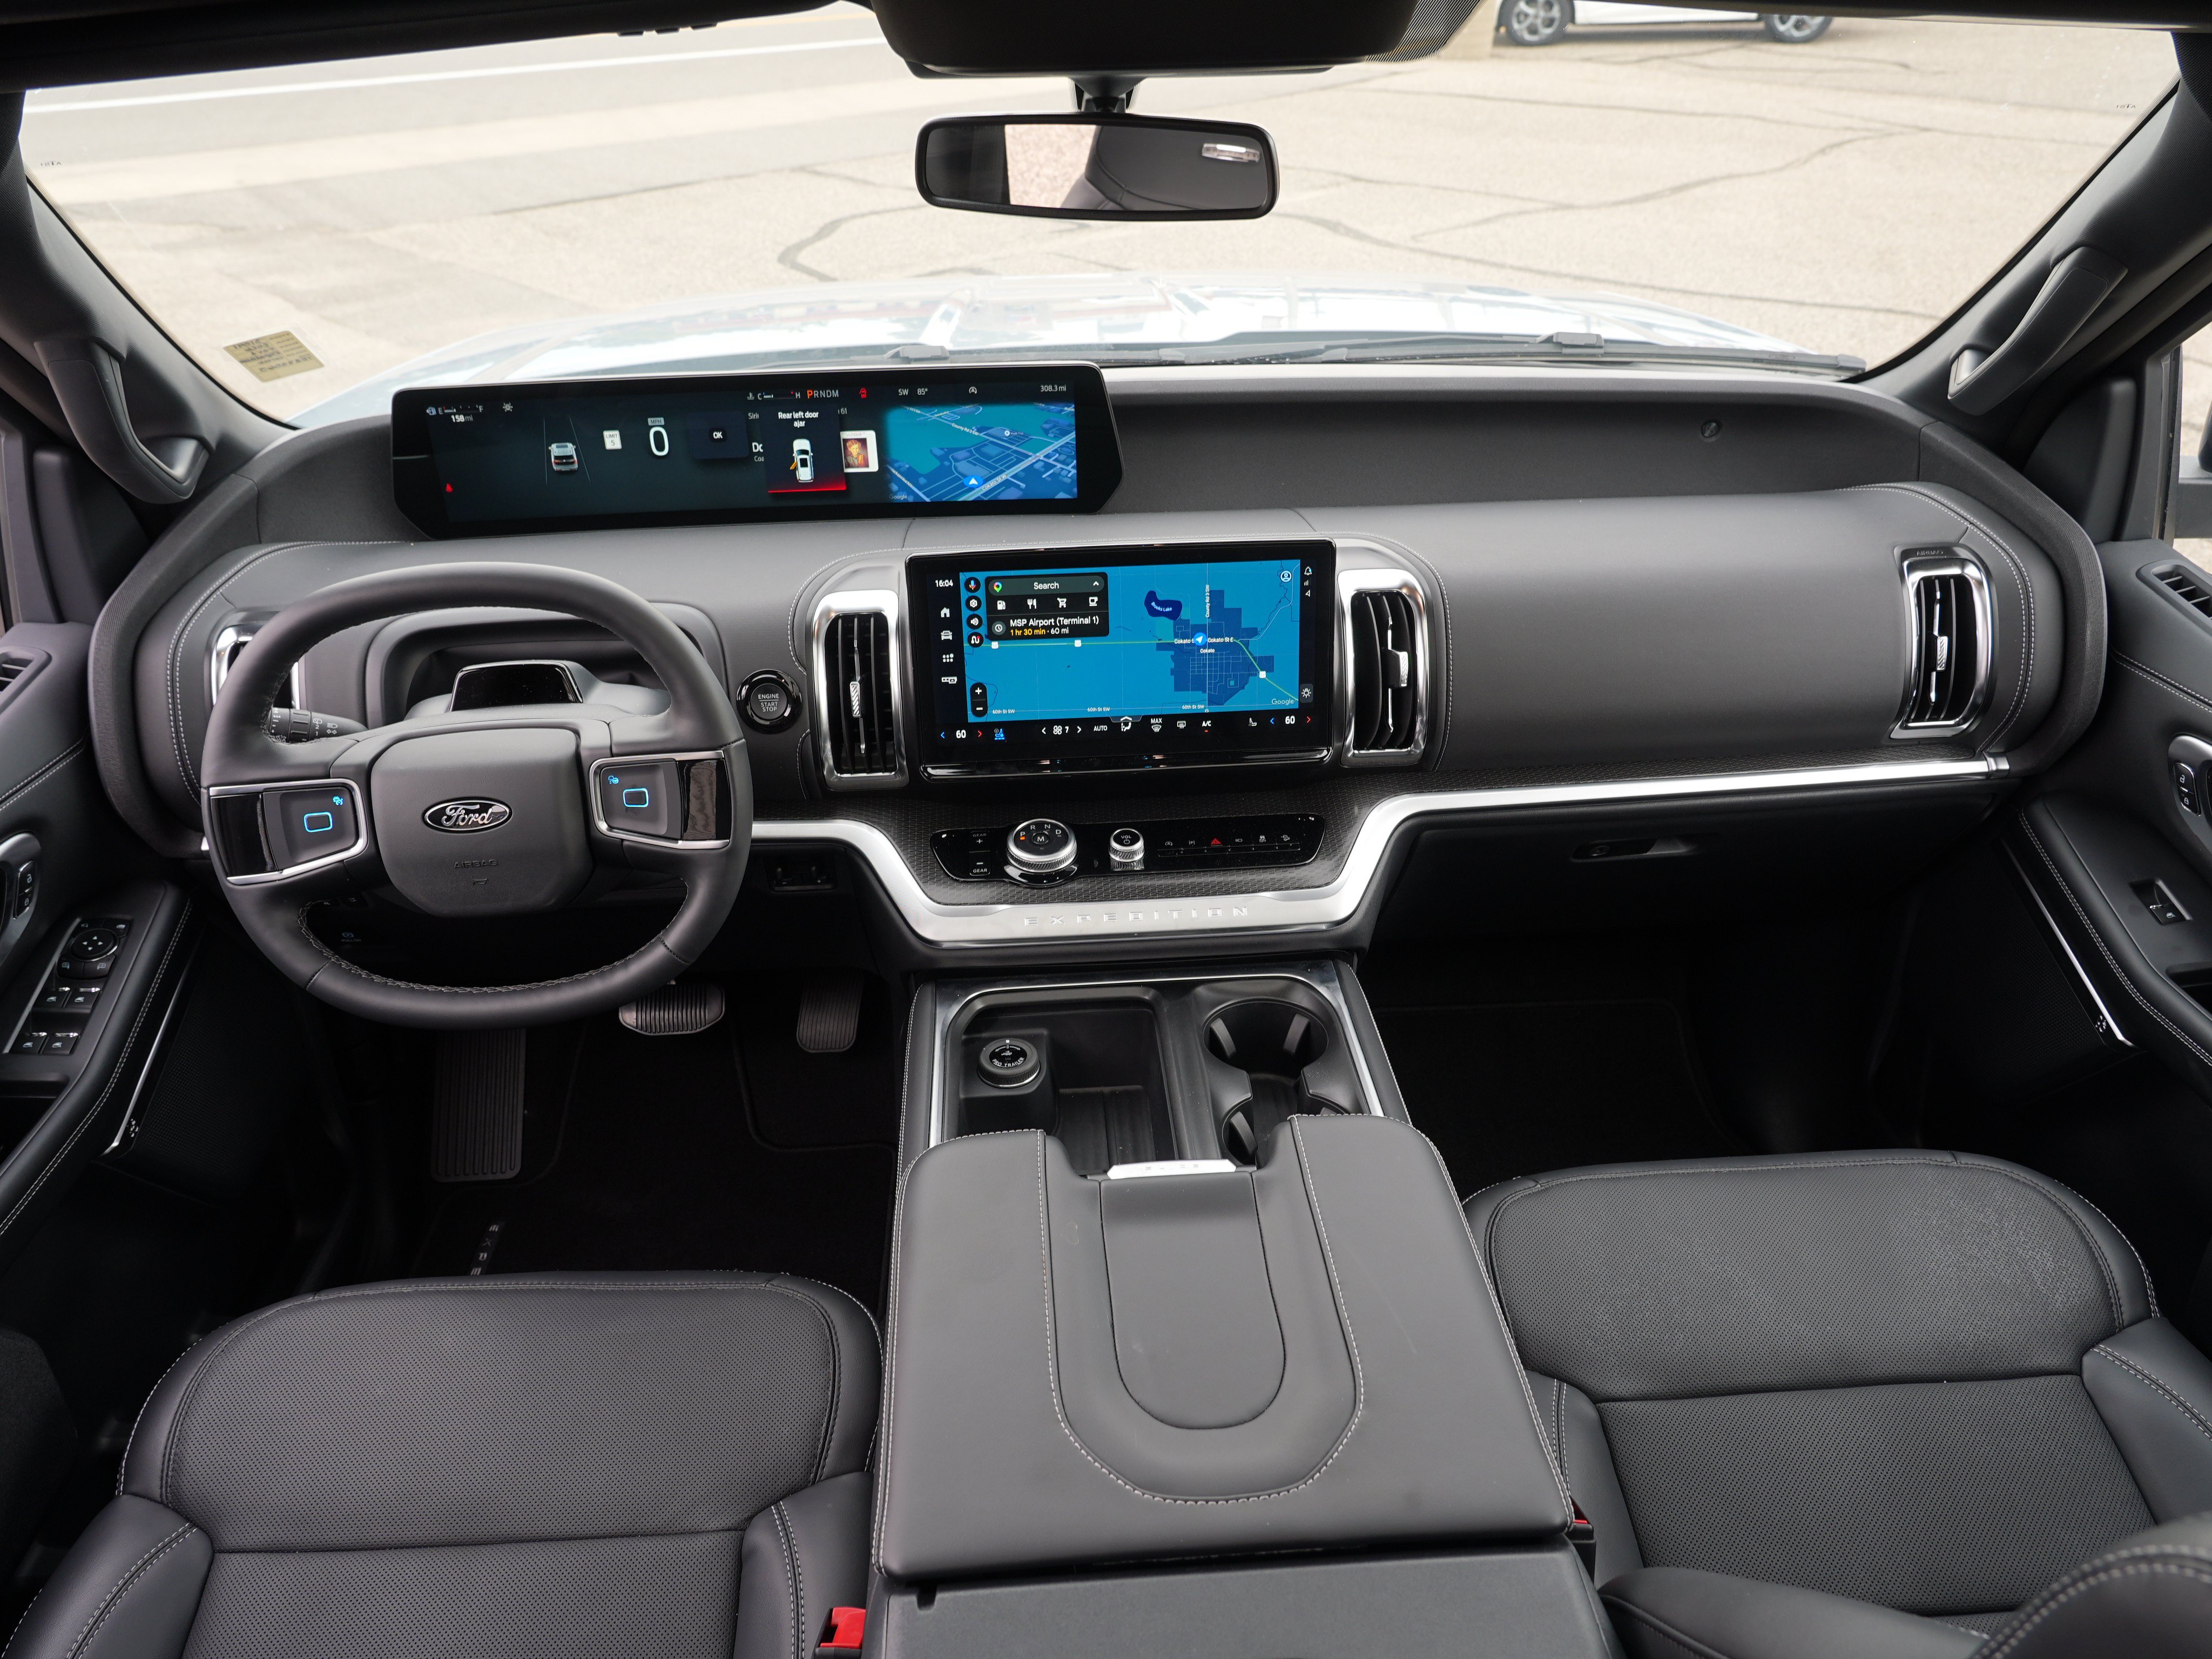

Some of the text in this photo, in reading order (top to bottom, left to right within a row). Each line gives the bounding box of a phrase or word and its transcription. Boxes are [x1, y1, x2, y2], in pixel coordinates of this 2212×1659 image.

[952, 423, 965, 431] County
[649, 426, 669, 456] 0
[981, 479, 996, 491] Cokato
[935, 579, 954, 588] 16:04
[1033, 581, 1060, 590] Search
[1205, 584, 1210, 592] SW
[1151, 602, 1163, 612] Brooks
[1010, 615, 1099, 628] MSP Airport (Terminal 1)
[1285, 715, 1295, 724] 60
[956, 730, 966, 739] 60
[1064, 726, 1069, 734] 7
[441, 804, 494, 827] Ford
[454, 859, 498, 869] AIRBAG
[1024, 906, 1248, 927] EXPEDITION
[992, 1057, 1025, 1068] PRO TRAILER
